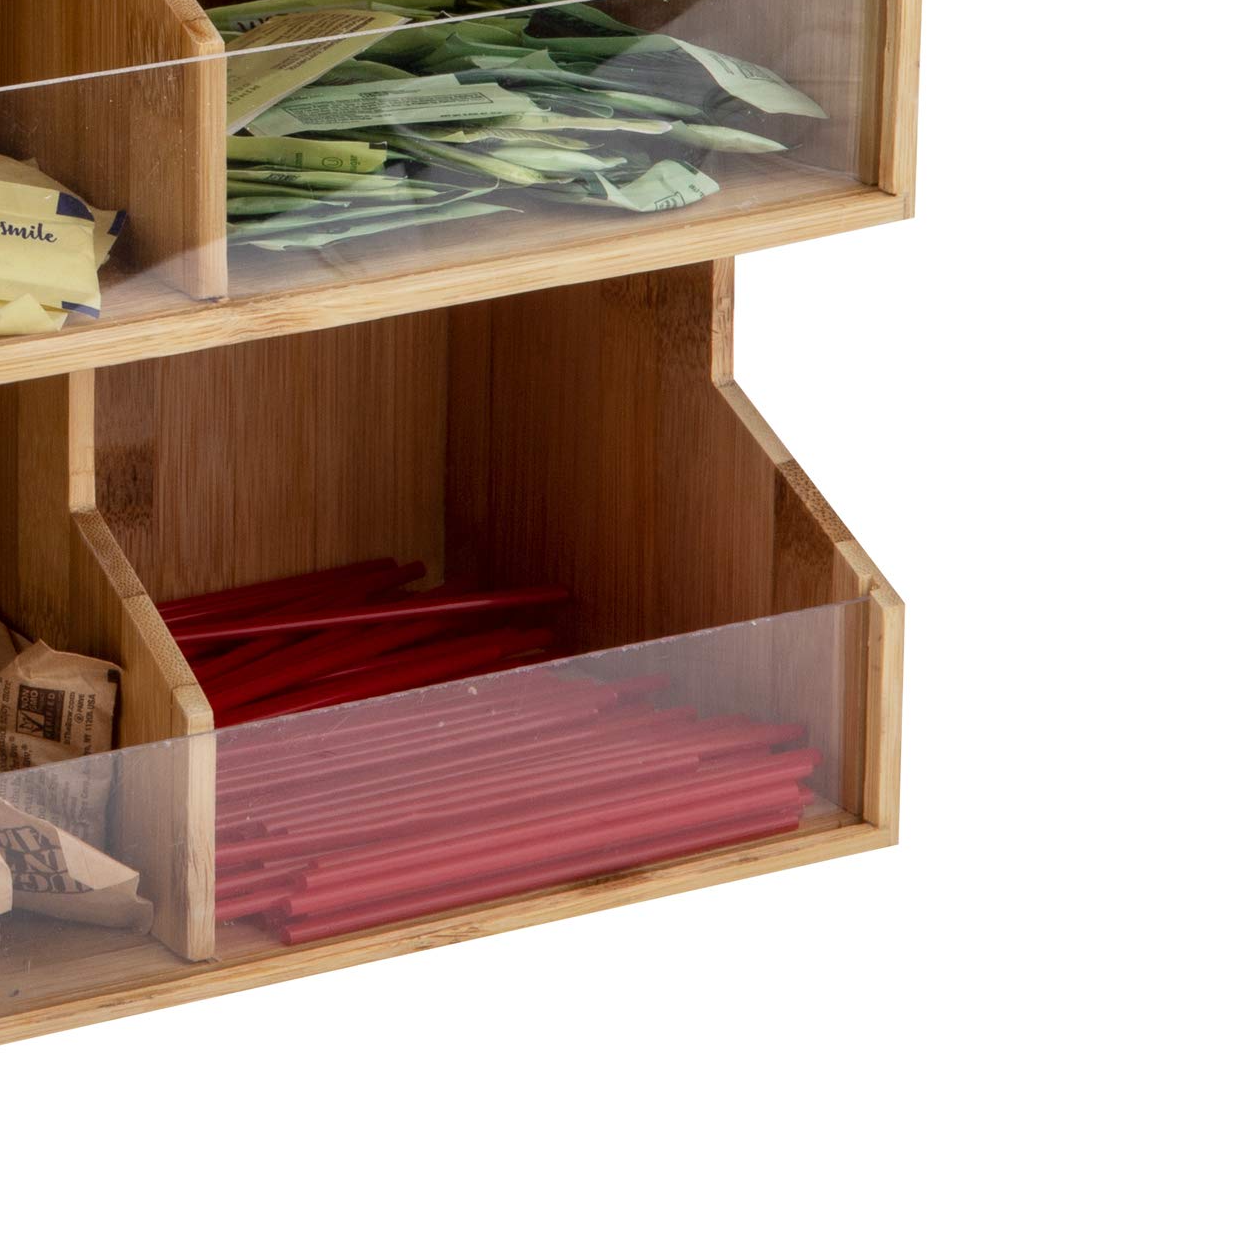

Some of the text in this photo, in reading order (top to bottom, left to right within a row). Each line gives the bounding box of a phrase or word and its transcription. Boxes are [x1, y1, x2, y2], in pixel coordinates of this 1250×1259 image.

[0, 220, 58, 243] smile
[2, 680, 11, 702] more
[21, 689, 29, 708] NON
[87, 692, 96, 709] USA
